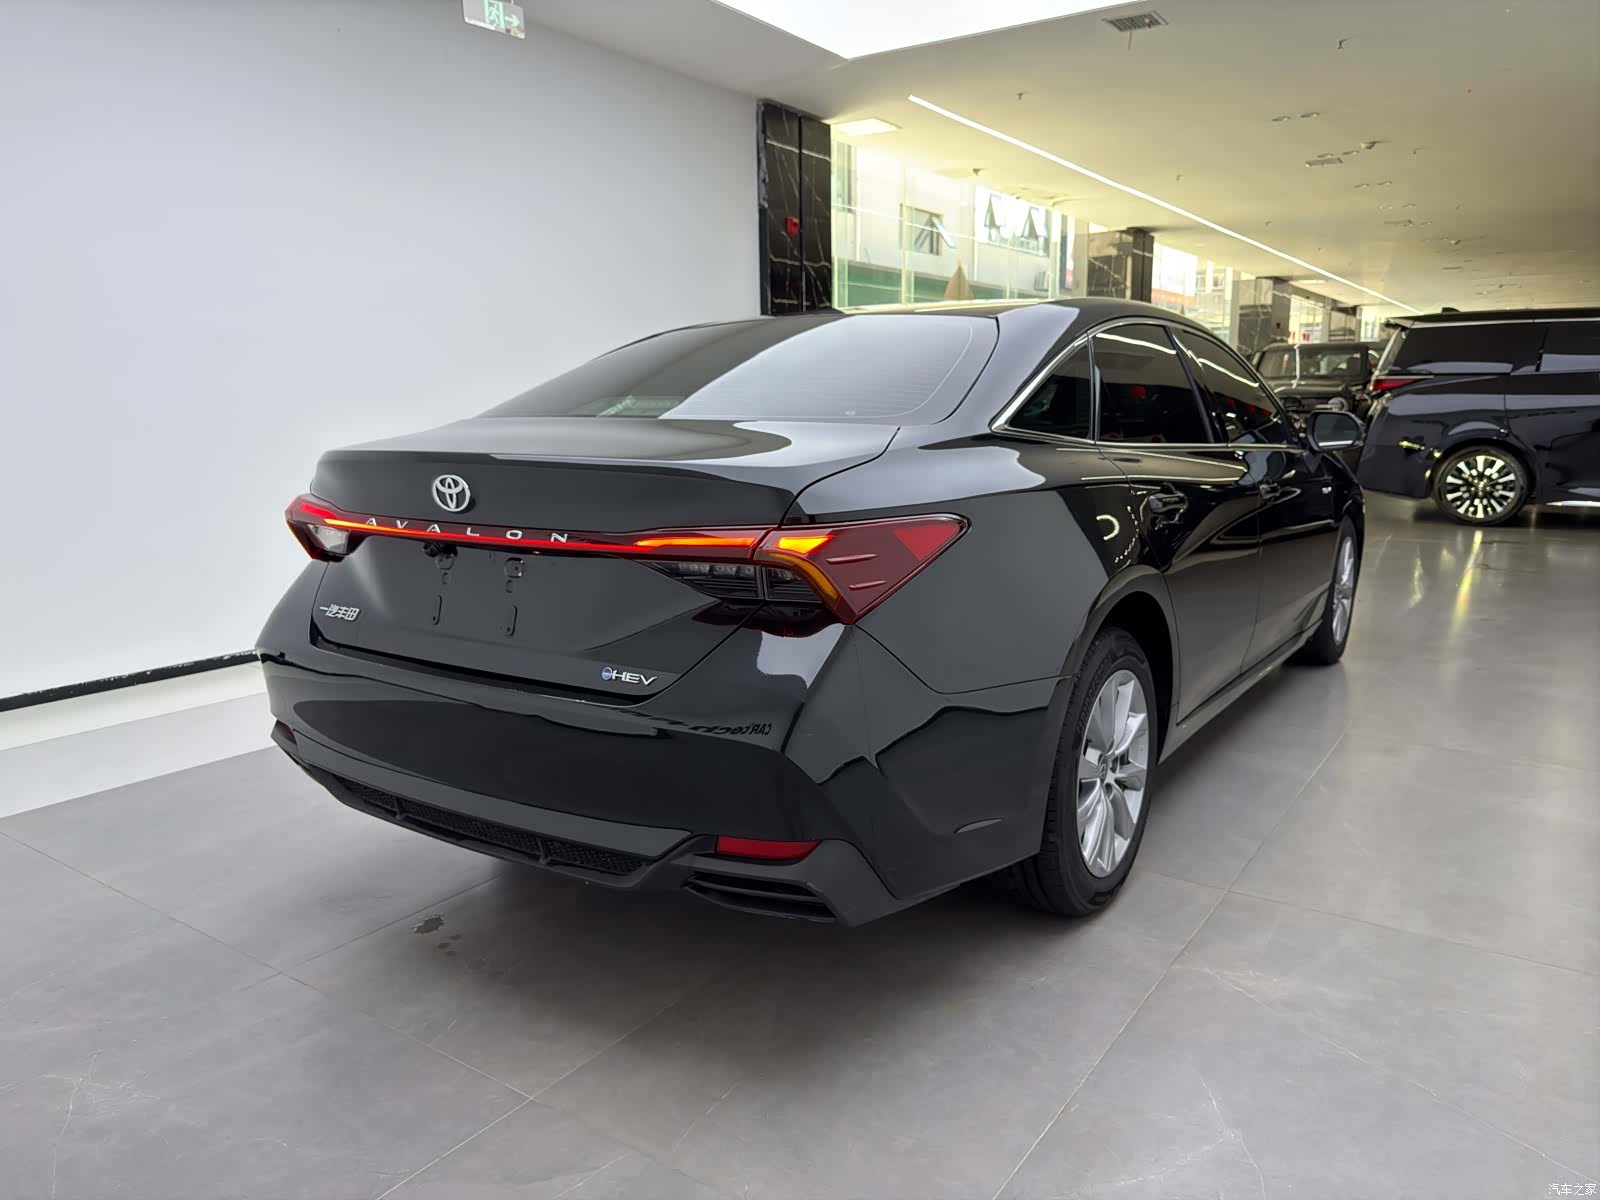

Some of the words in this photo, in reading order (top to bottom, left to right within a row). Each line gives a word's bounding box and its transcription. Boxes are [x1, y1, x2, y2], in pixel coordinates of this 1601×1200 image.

[366, 517, 568, 543] AVALON
[320, 604, 360, 621] 一汽丰田
[611, 669, 658, 686] HEV
